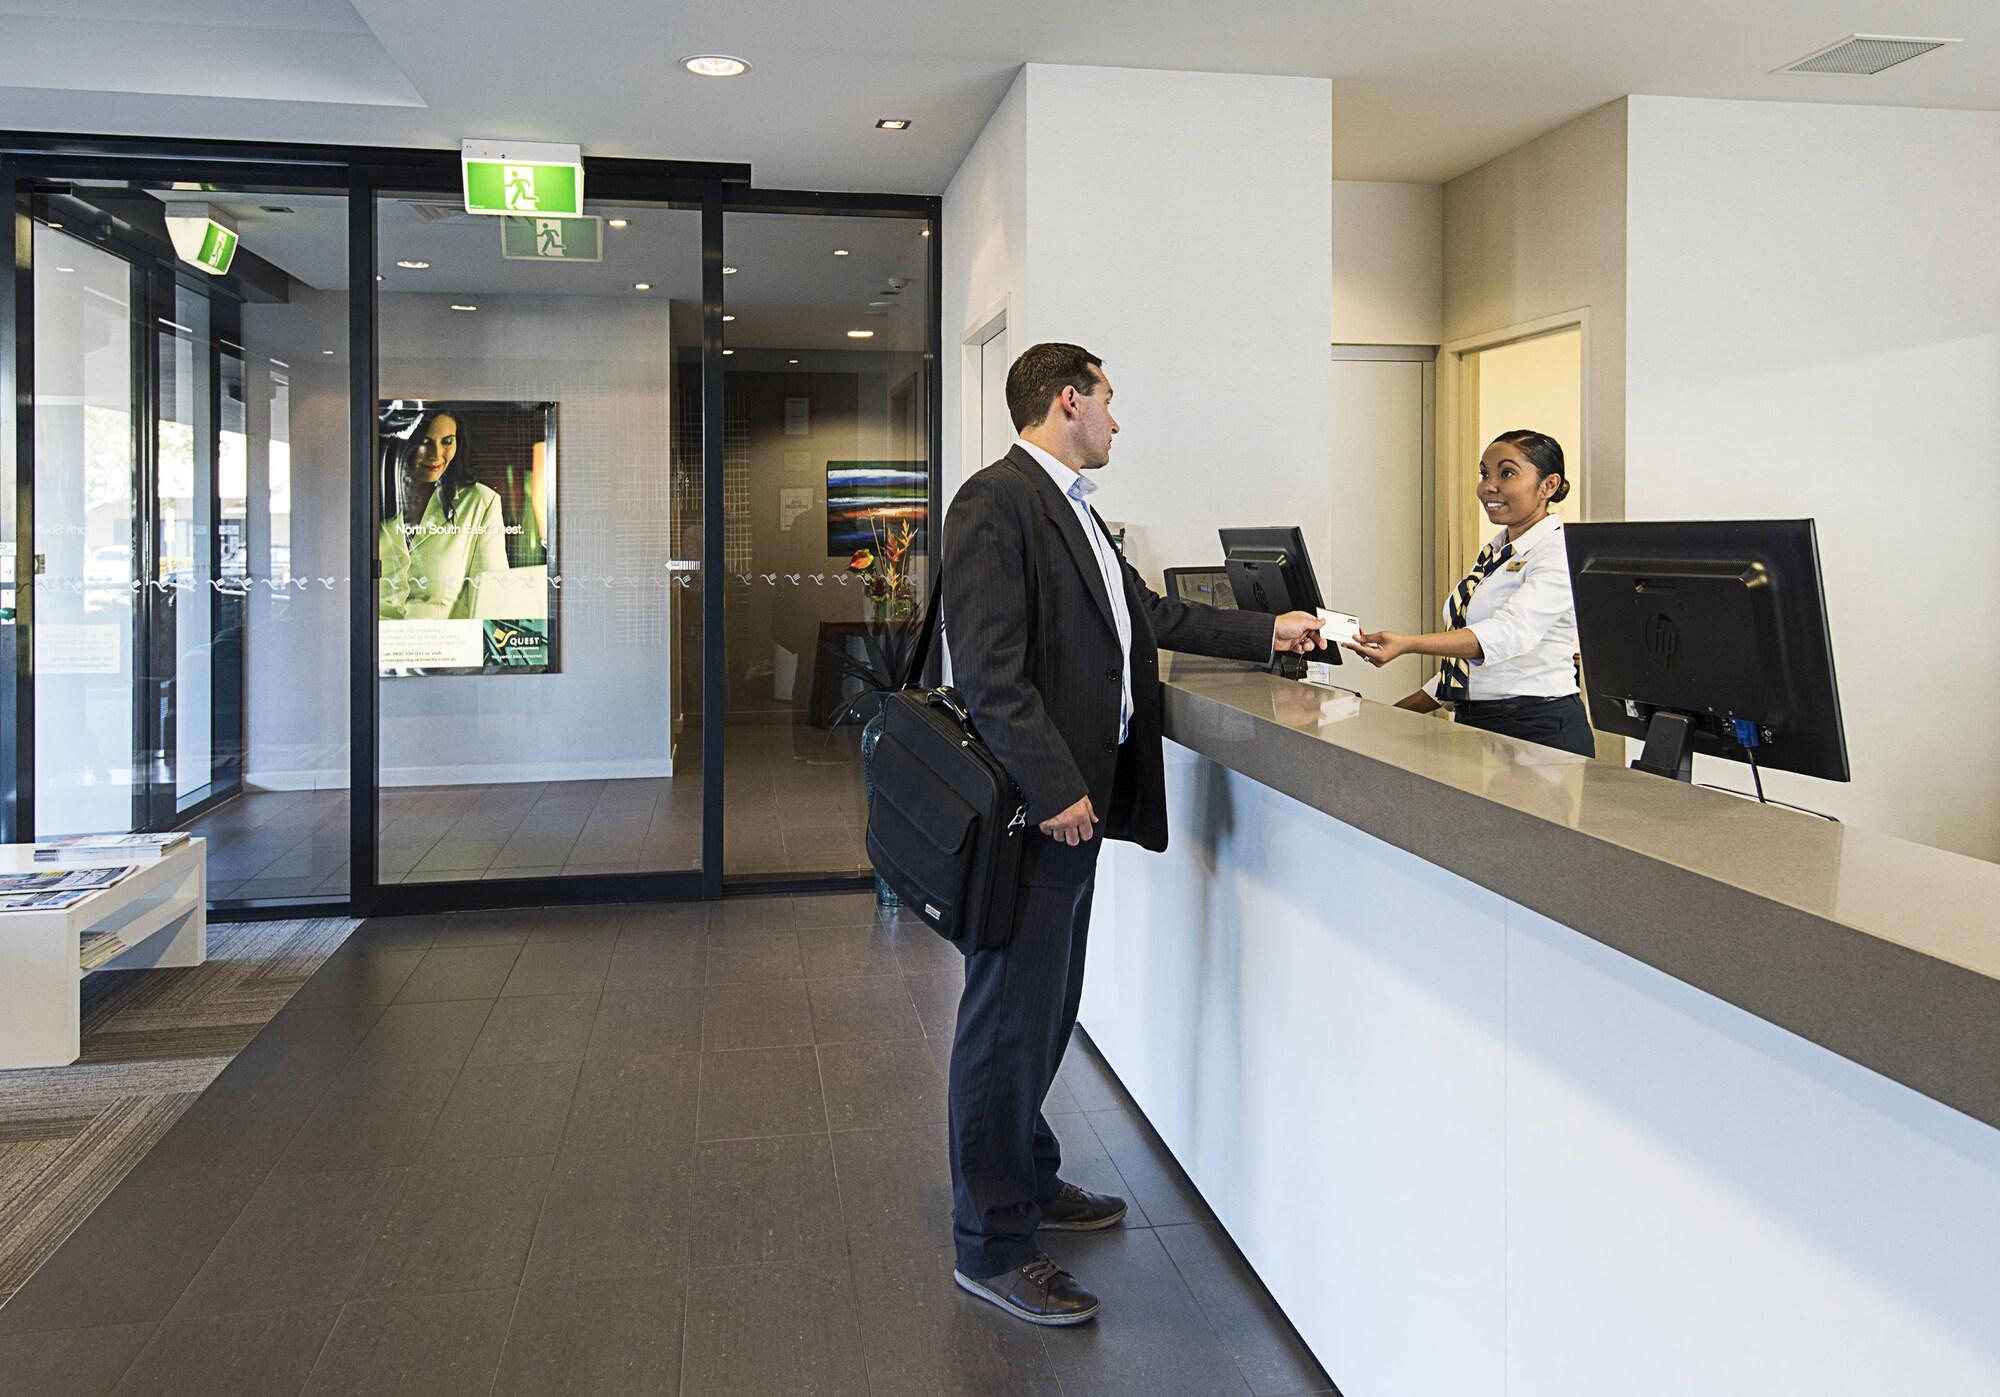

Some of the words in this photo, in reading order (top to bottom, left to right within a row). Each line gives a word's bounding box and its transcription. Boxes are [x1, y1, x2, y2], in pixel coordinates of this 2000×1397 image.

[396, 524, 426, 535] North
[429, 524, 460, 535] South
[464, 524, 488, 535] East
[509, 637, 540, 646] QUEST
